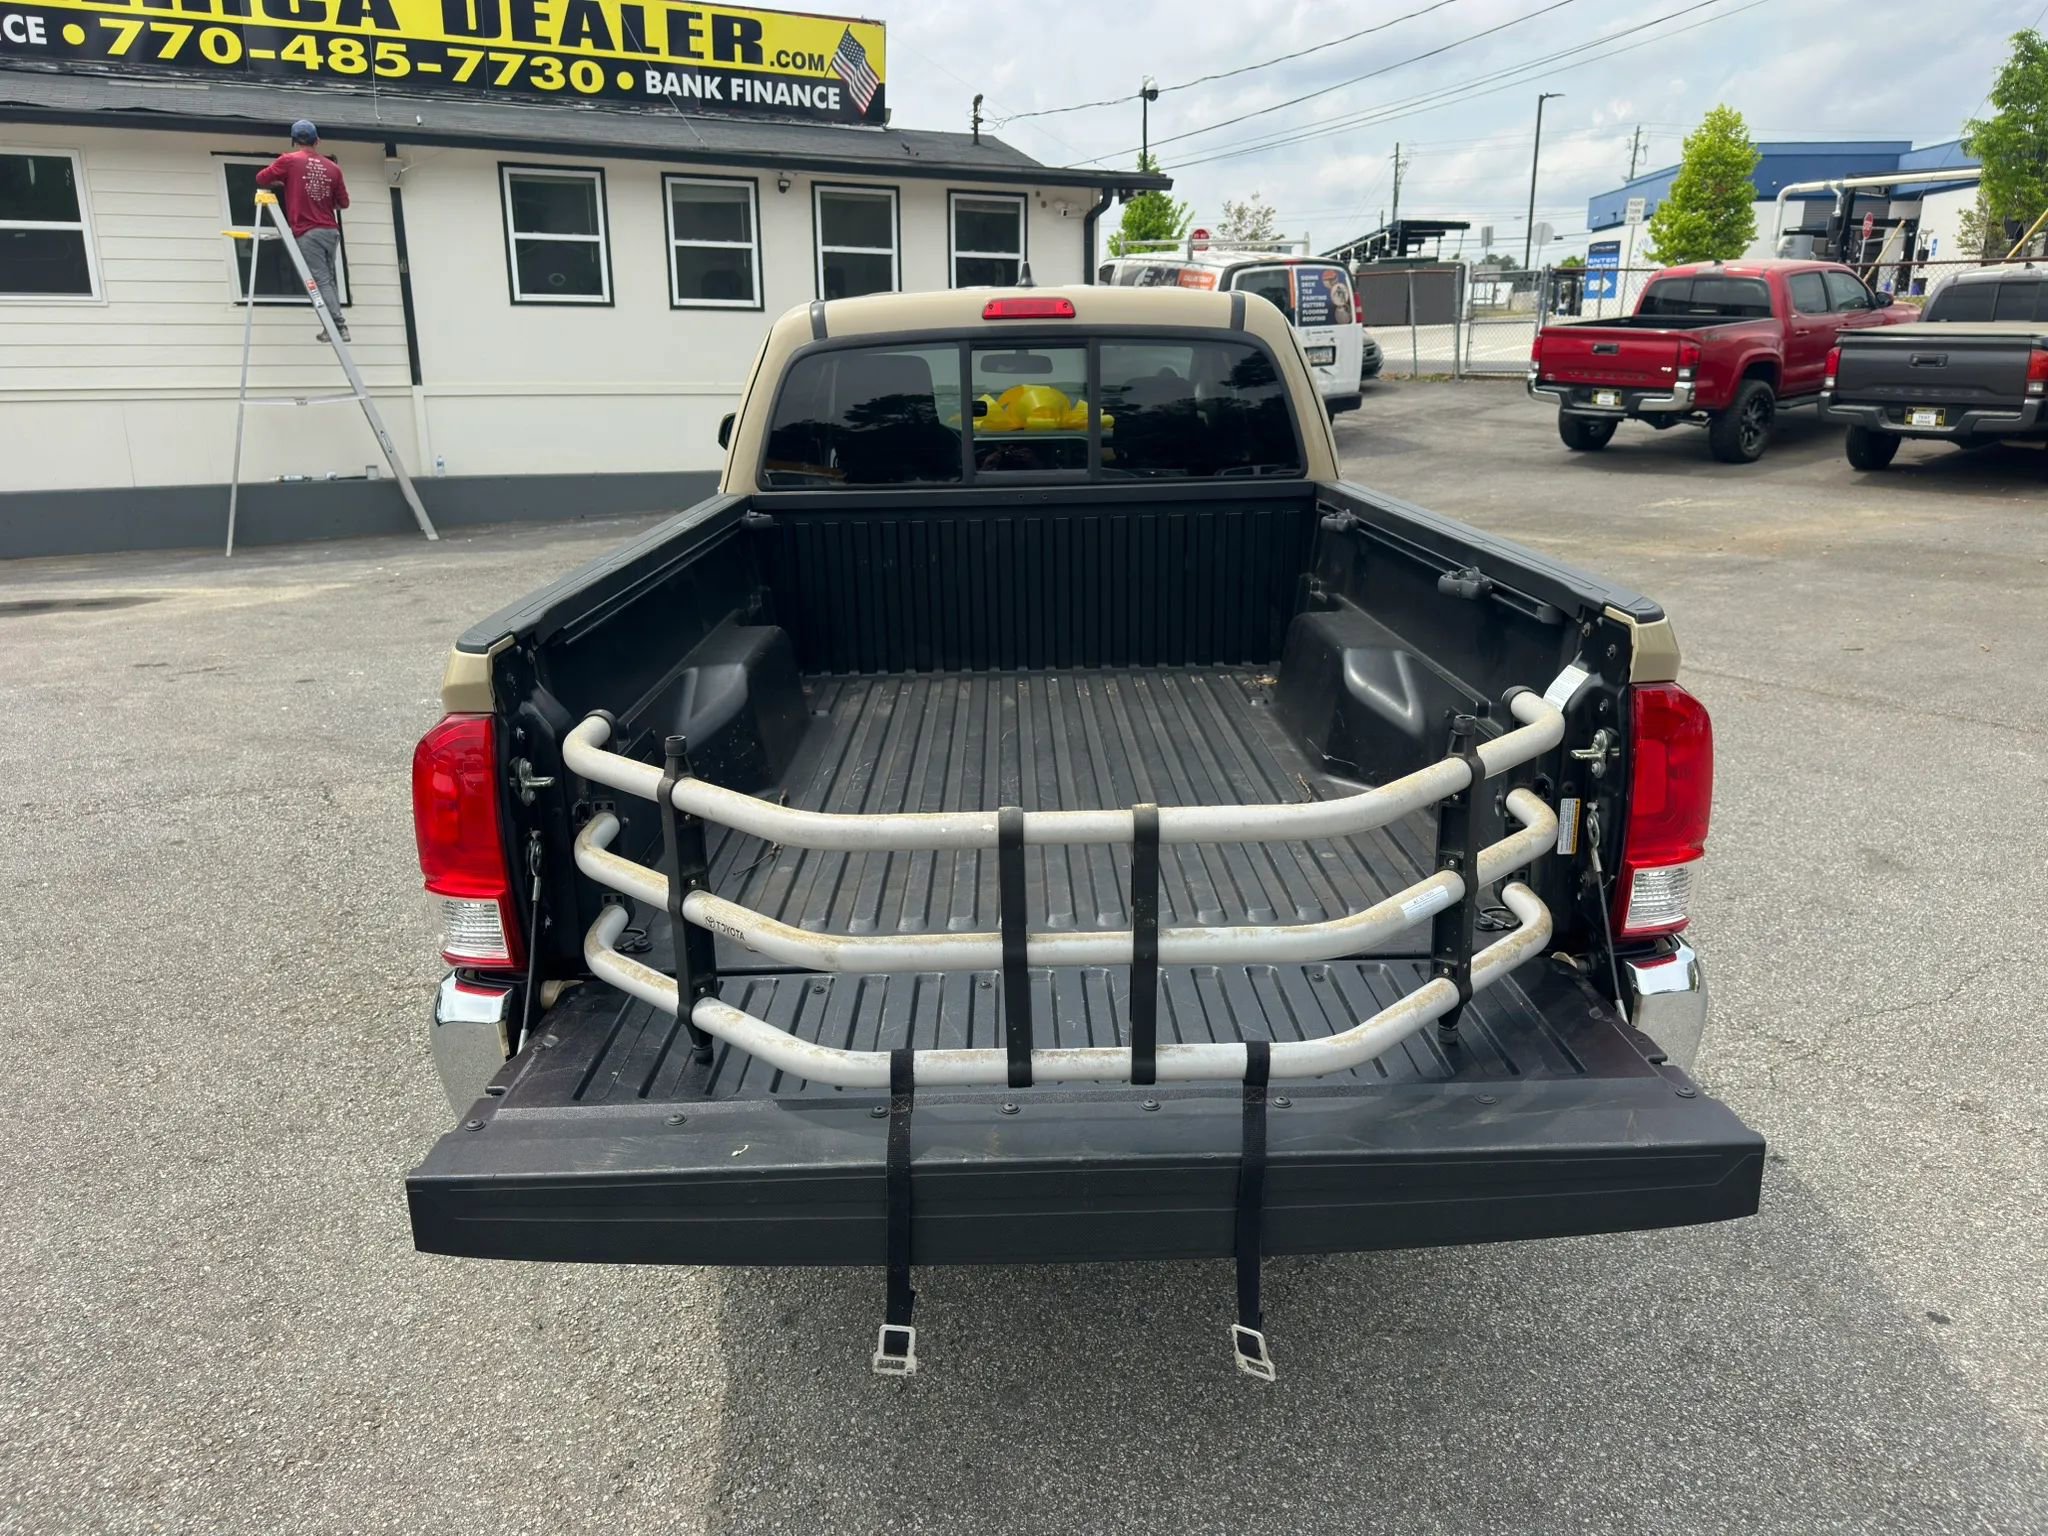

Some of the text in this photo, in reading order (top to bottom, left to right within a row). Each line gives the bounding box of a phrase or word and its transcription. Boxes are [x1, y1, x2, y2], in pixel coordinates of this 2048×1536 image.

[0, 13, 47, 45] CE
[99, 17, 606, 94] 770-485-7730
[645, 69, 723, 101] BANK
[730, 77, 841, 111] FINANCE
